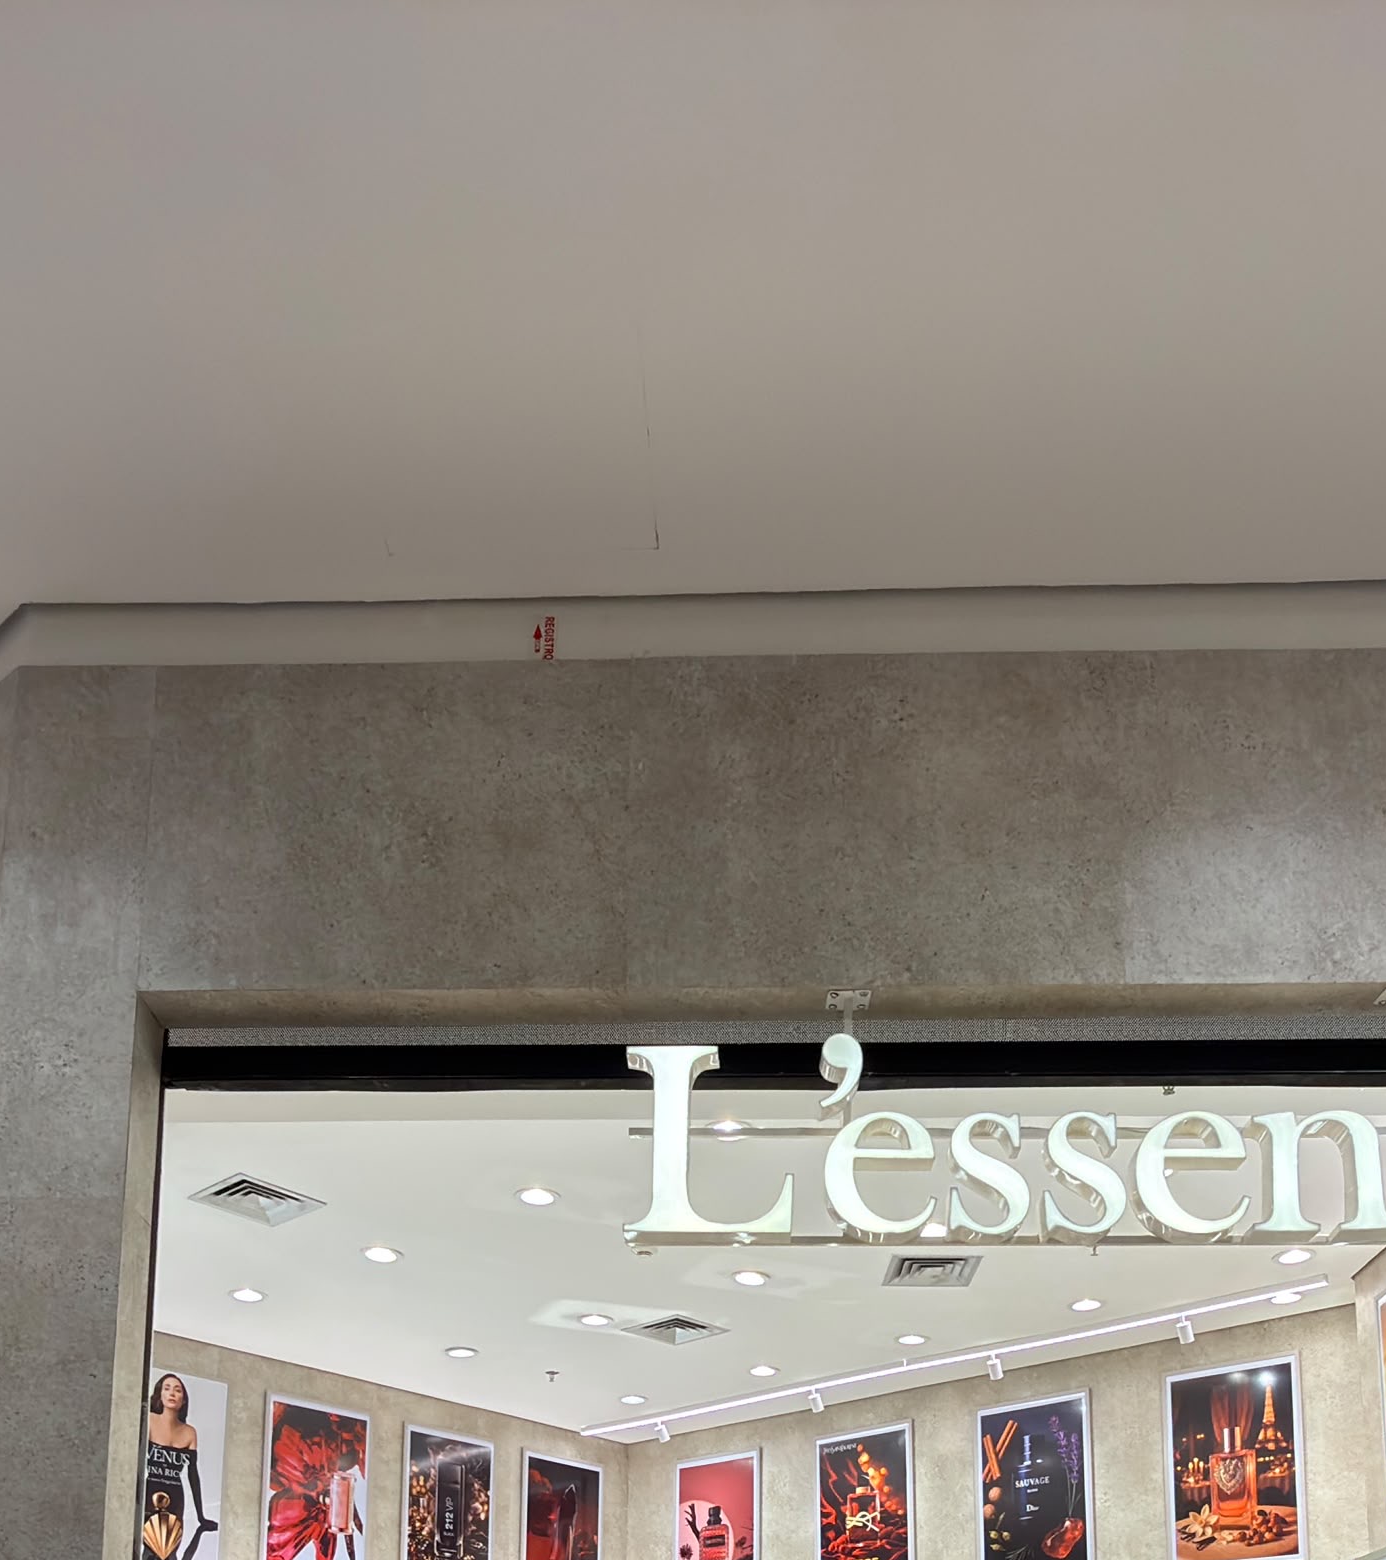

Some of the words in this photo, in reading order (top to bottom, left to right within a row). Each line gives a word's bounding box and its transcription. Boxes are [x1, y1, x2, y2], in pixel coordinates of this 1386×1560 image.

[543, 615, 555, 660] REGISTRO
[1015, 1475, 1050, 1488] SAUVAGE
[445, 1512, 454, 1530] 212
